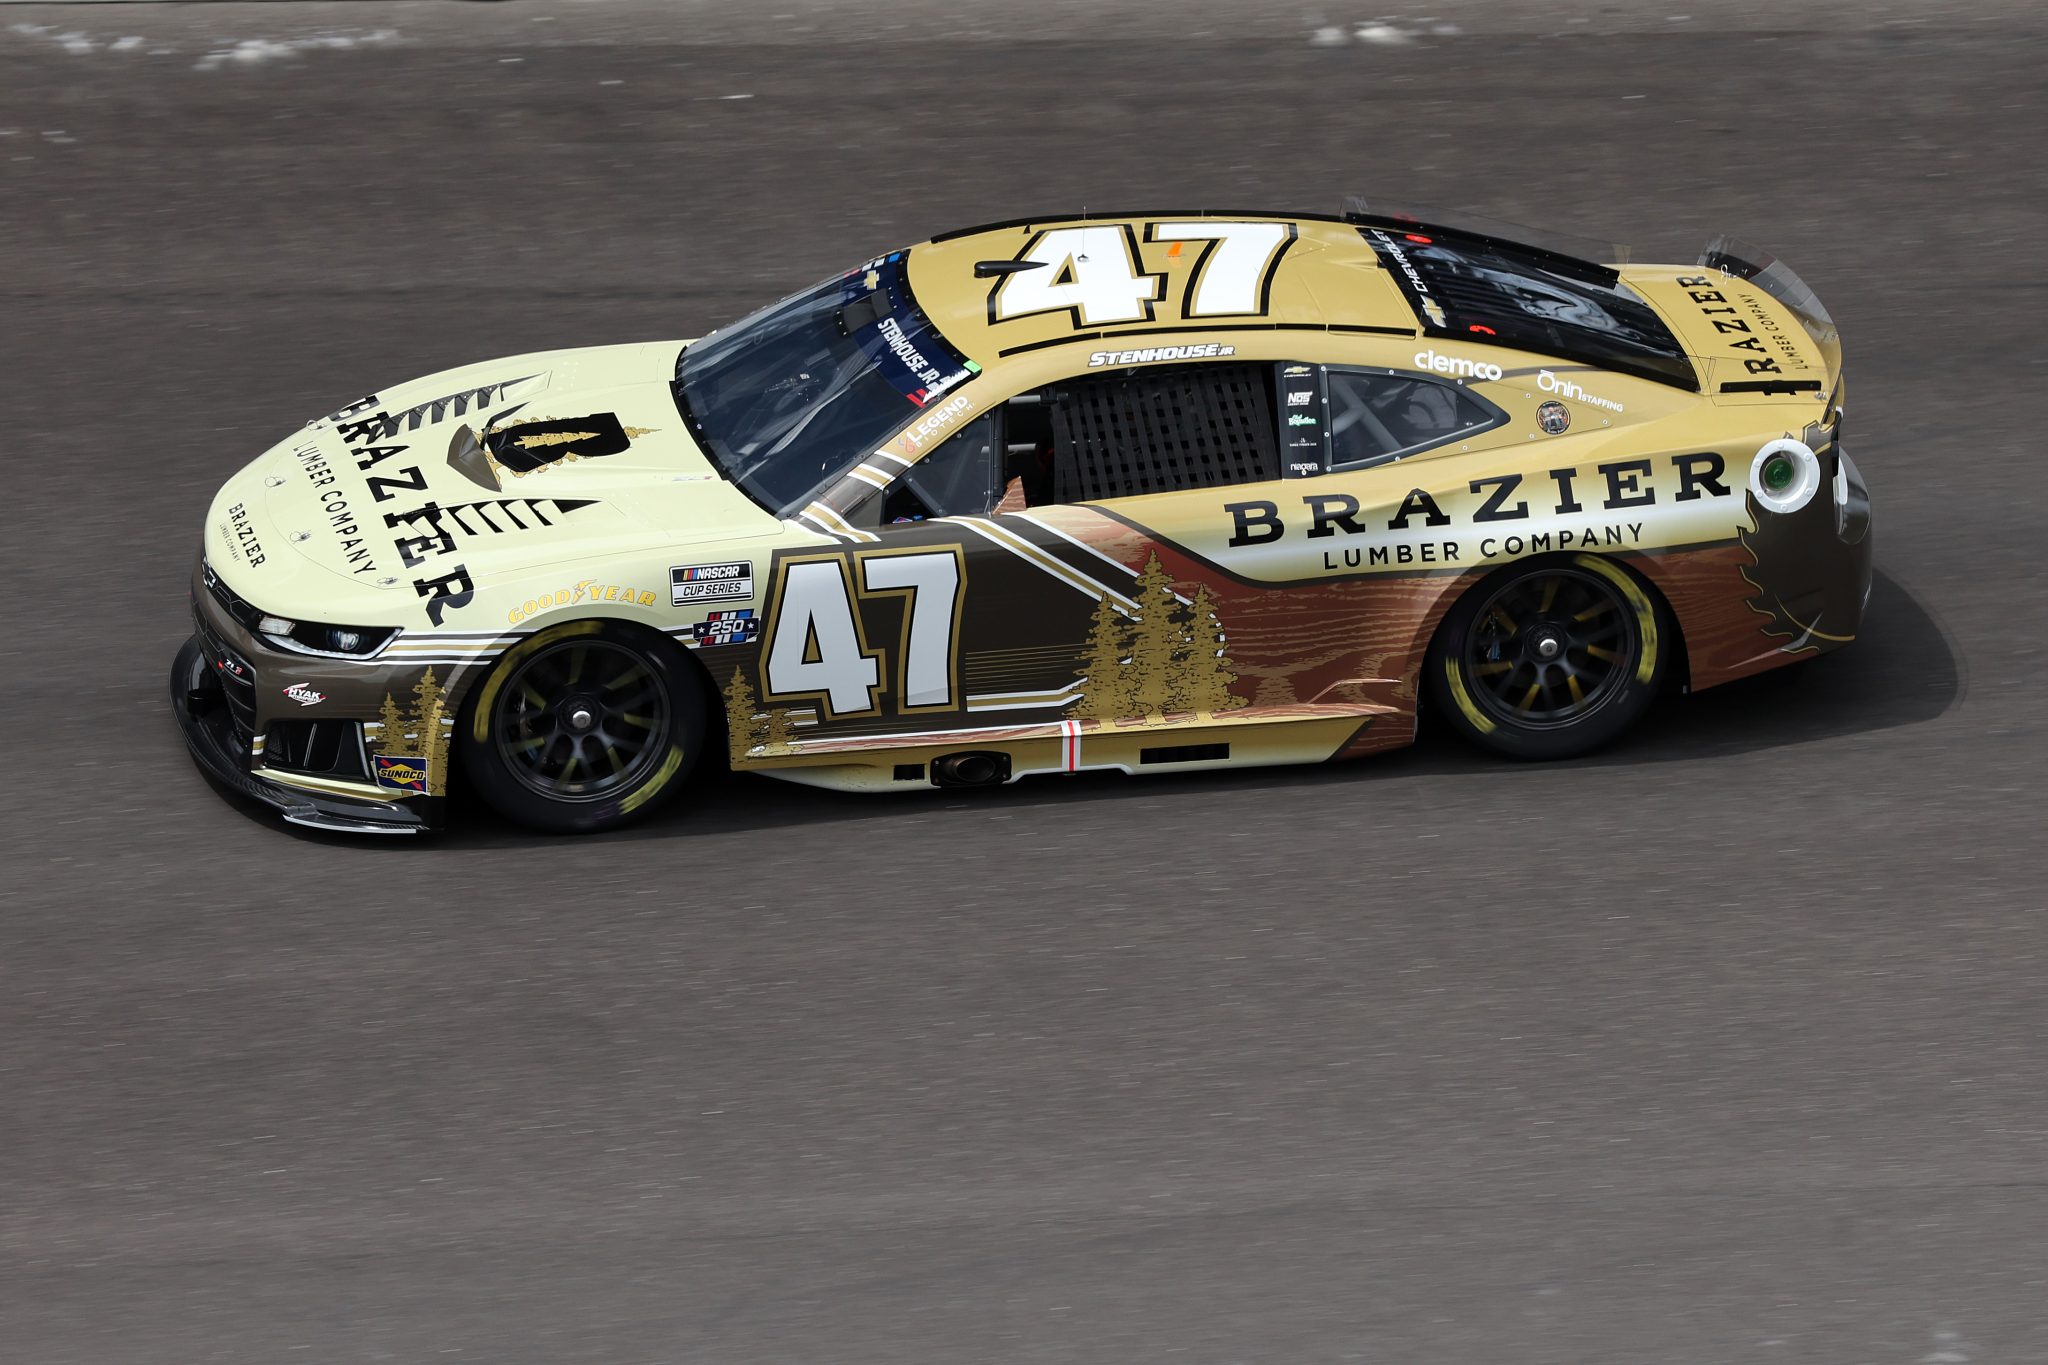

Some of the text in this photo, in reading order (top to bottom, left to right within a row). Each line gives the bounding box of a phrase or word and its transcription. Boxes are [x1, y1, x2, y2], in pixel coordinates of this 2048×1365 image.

[989, 222, 1296, 330] 47
[1371, 229, 1428, 292] CHEVROLET
[878, 317, 928, 373] STENHOUSE
[1088, 343, 1221, 367] STENHOUSE
[1738, 293, 1809, 370] LUMBER COMPANY
[1414, 350, 1503, 381] clemco
[906, 396, 968, 442] LEGEND
[1288, 391, 1313, 403] NOS
[1581, 393, 1624, 413] STAFFING
[293, 440, 377, 574] LUMBER COMPANY
[327, 394, 475, 628] BRAZIER
[1223, 451, 1732, 548] BRAZIER
[228, 502, 266, 568] BRAZIER
[1323, 522, 1644, 570] LUMBER COMPANY
[683, 582, 741, 596] CUP SERIES
[696, 565, 740, 579] NASCAR
[708, 620, 744, 635] 250
[766, 551, 961, 717] 47
[288, 687, 321, 699] HYAK
[380, 768, 425, 780] SUNOCO
